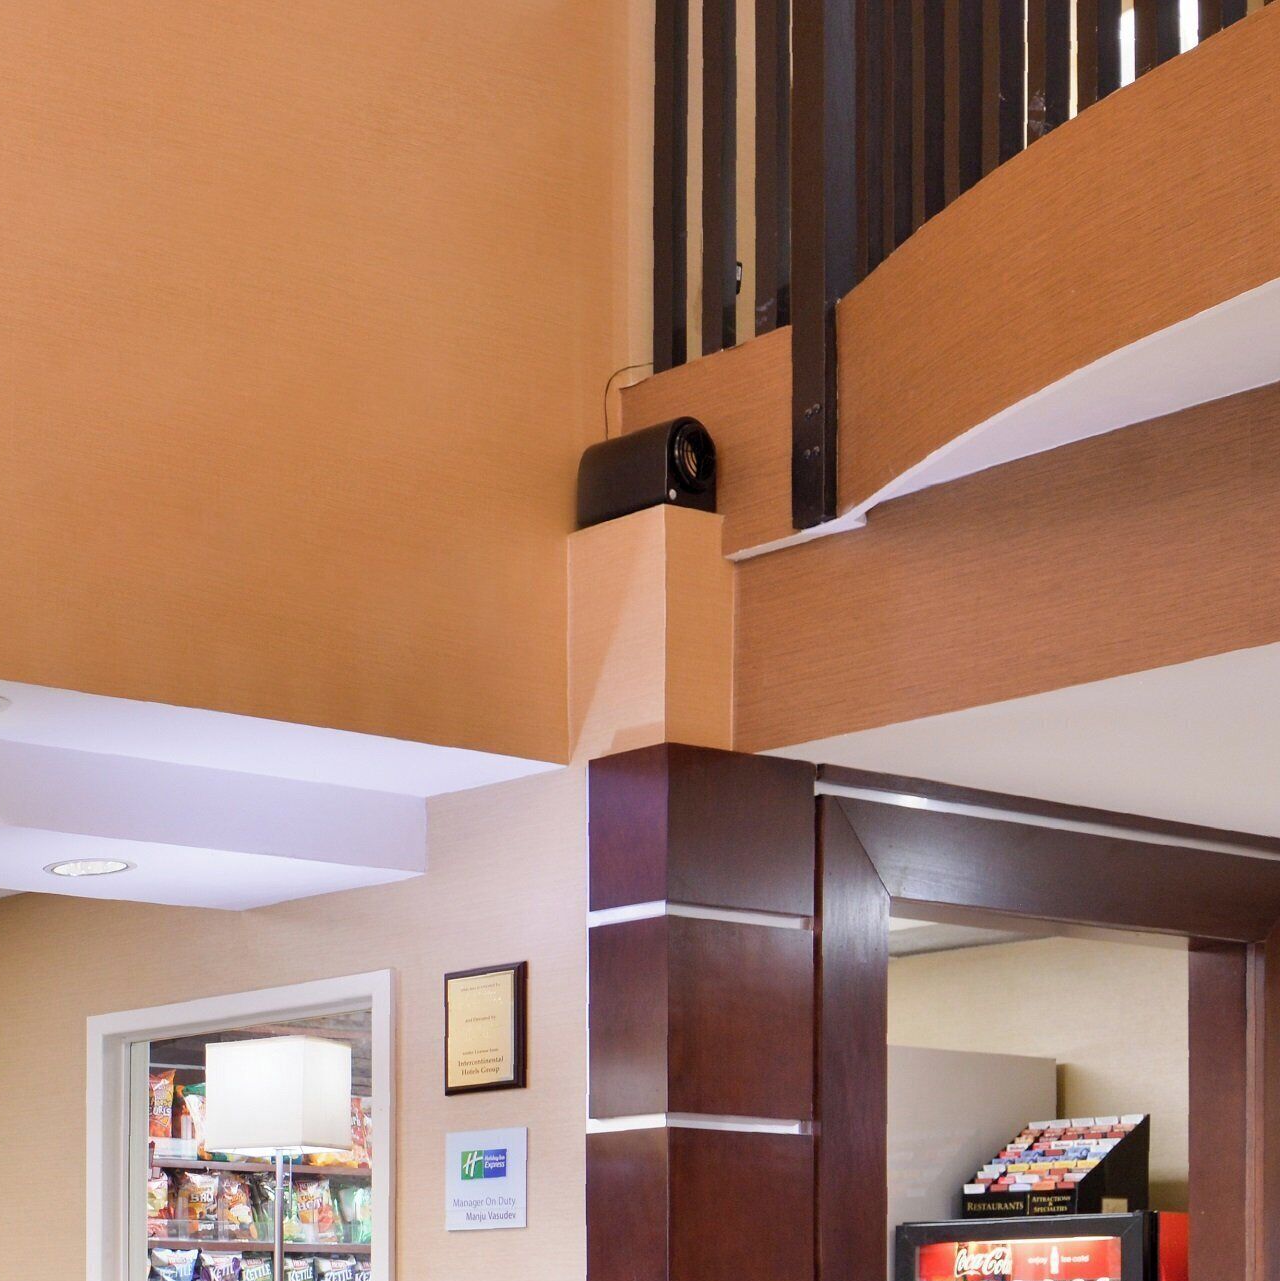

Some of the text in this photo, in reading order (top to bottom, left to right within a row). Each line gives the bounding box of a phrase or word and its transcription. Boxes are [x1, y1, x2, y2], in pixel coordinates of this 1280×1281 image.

[484, 1161, 505, 1169] Express
[453, 1196, 517, 1209] Manager On Duty
[967, 1201, 1024, 1211] RESTAURANTS
[466, 1209, 516, 1222] Manju Vasudev
